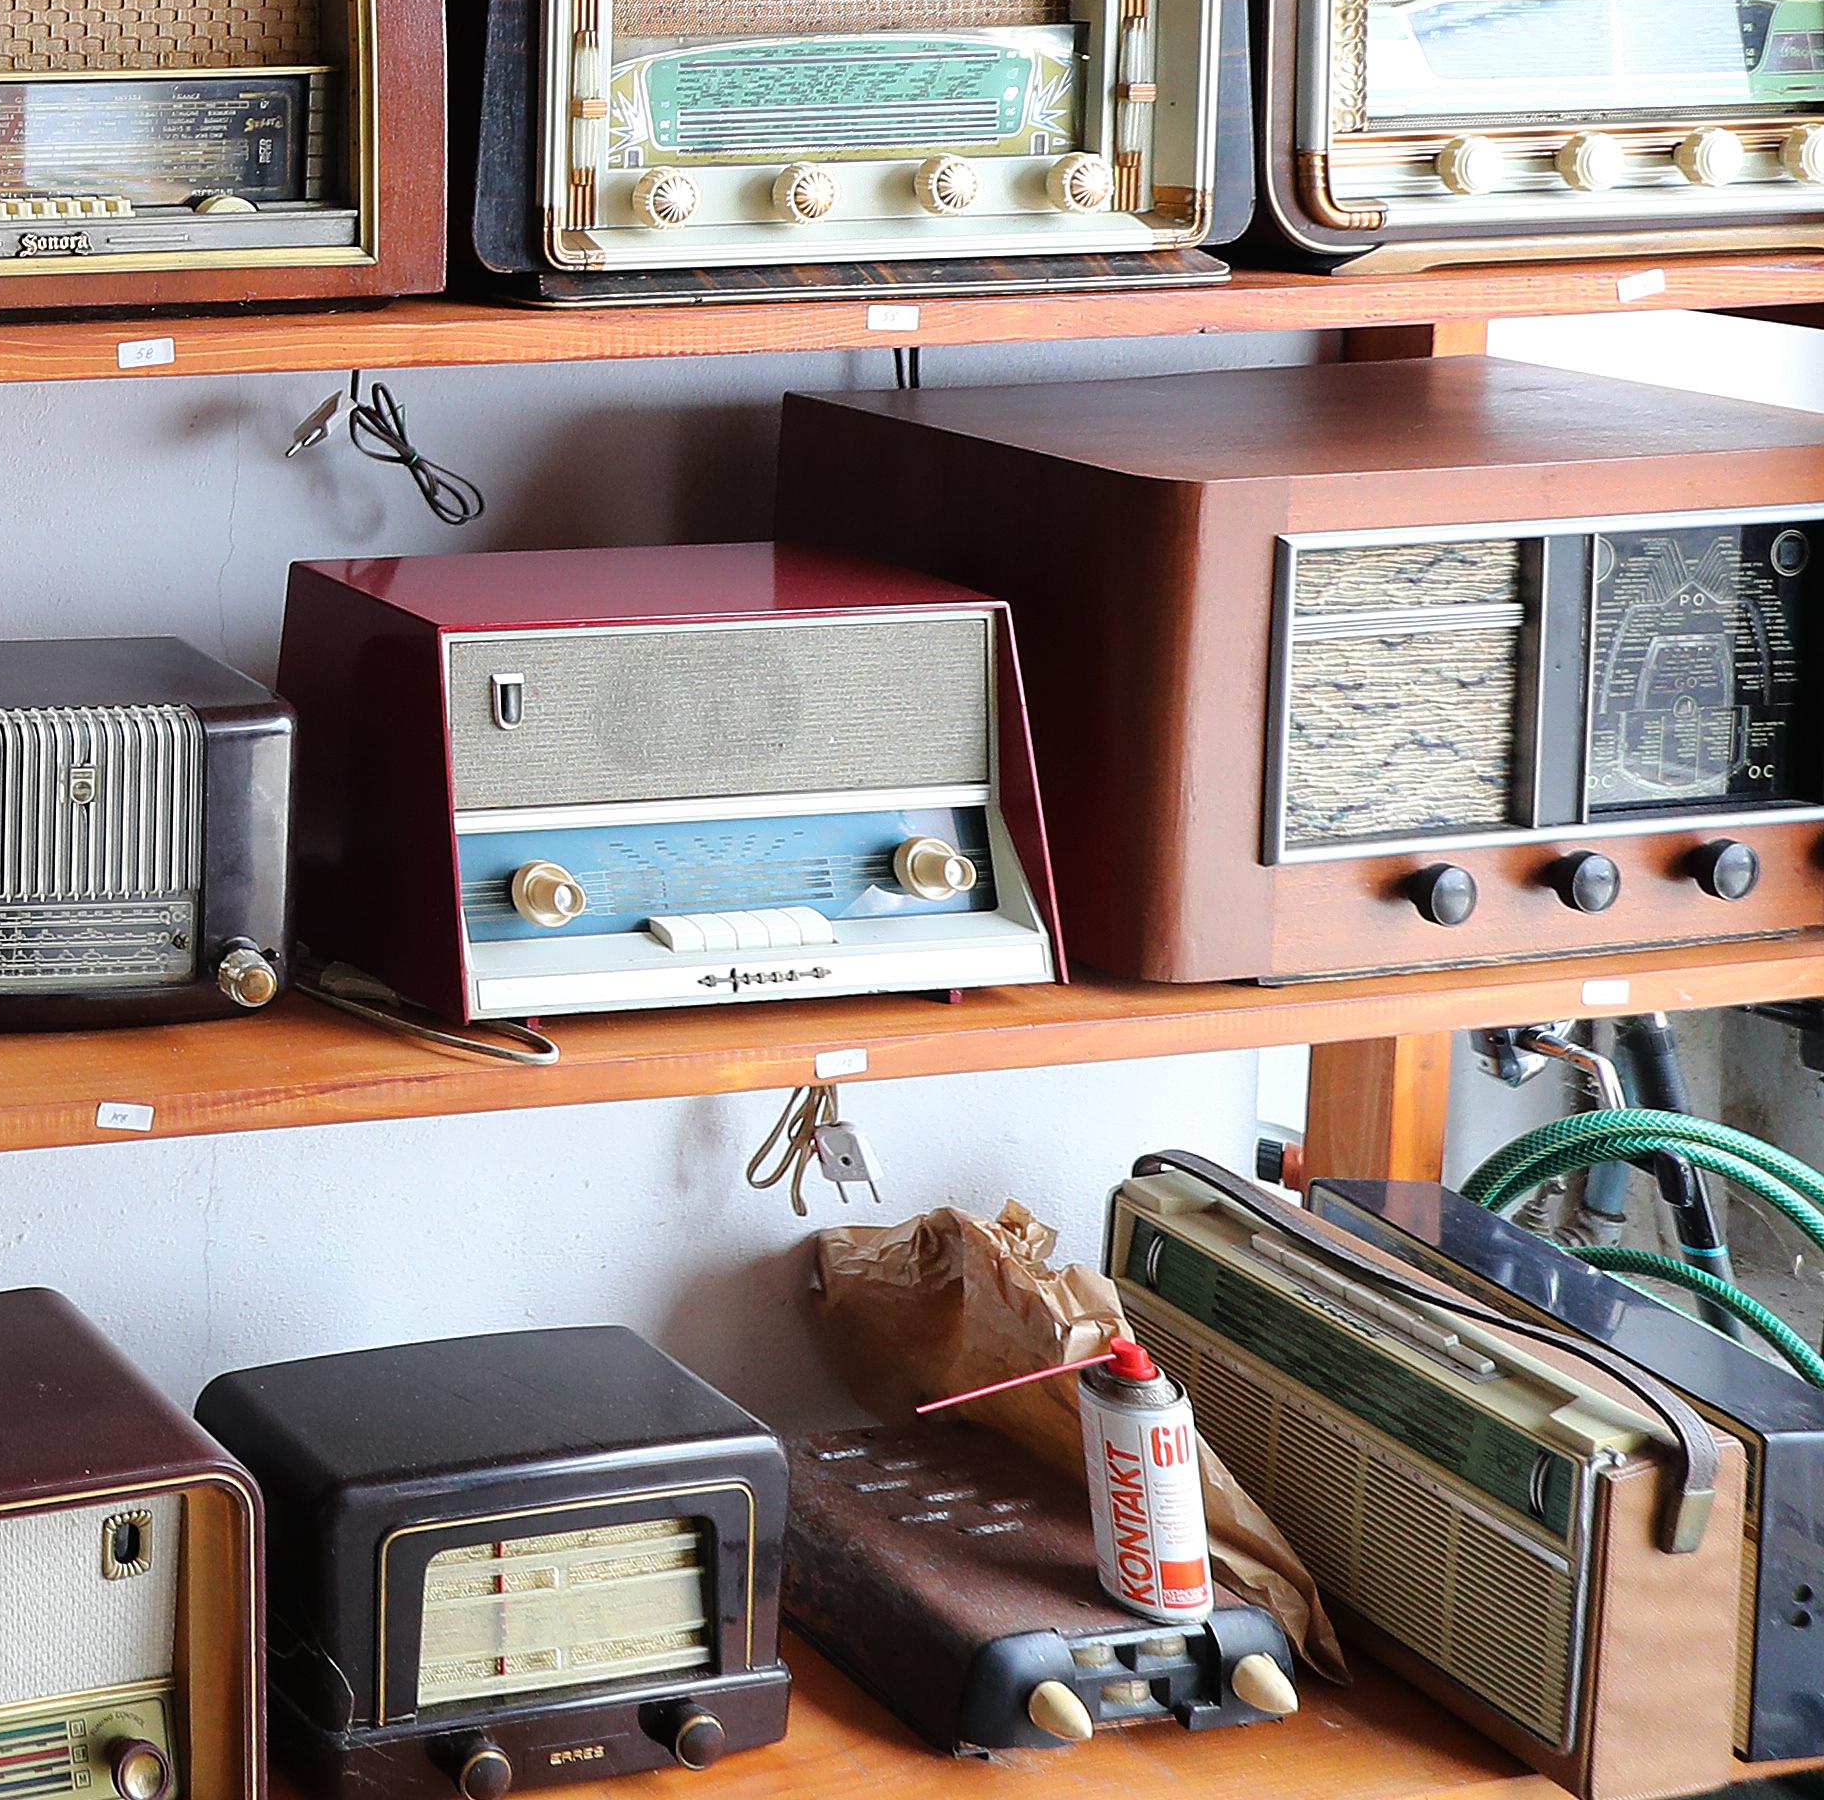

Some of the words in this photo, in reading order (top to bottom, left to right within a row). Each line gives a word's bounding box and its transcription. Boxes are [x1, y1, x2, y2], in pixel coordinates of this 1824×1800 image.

[19, 231, 95, 258] Sonora
[135, 347, 154, 360] 58
[1679, 592, 1705, 607] PO
[1674, 676, 1698, 689] GO
[1748, 764, 1775, 780] OC
[1151, 1424, 1190, 1469] 60
[1106, 1439, 1158, 1607] KONTAKT
[550, 1745, 606, 1766] ERRES
